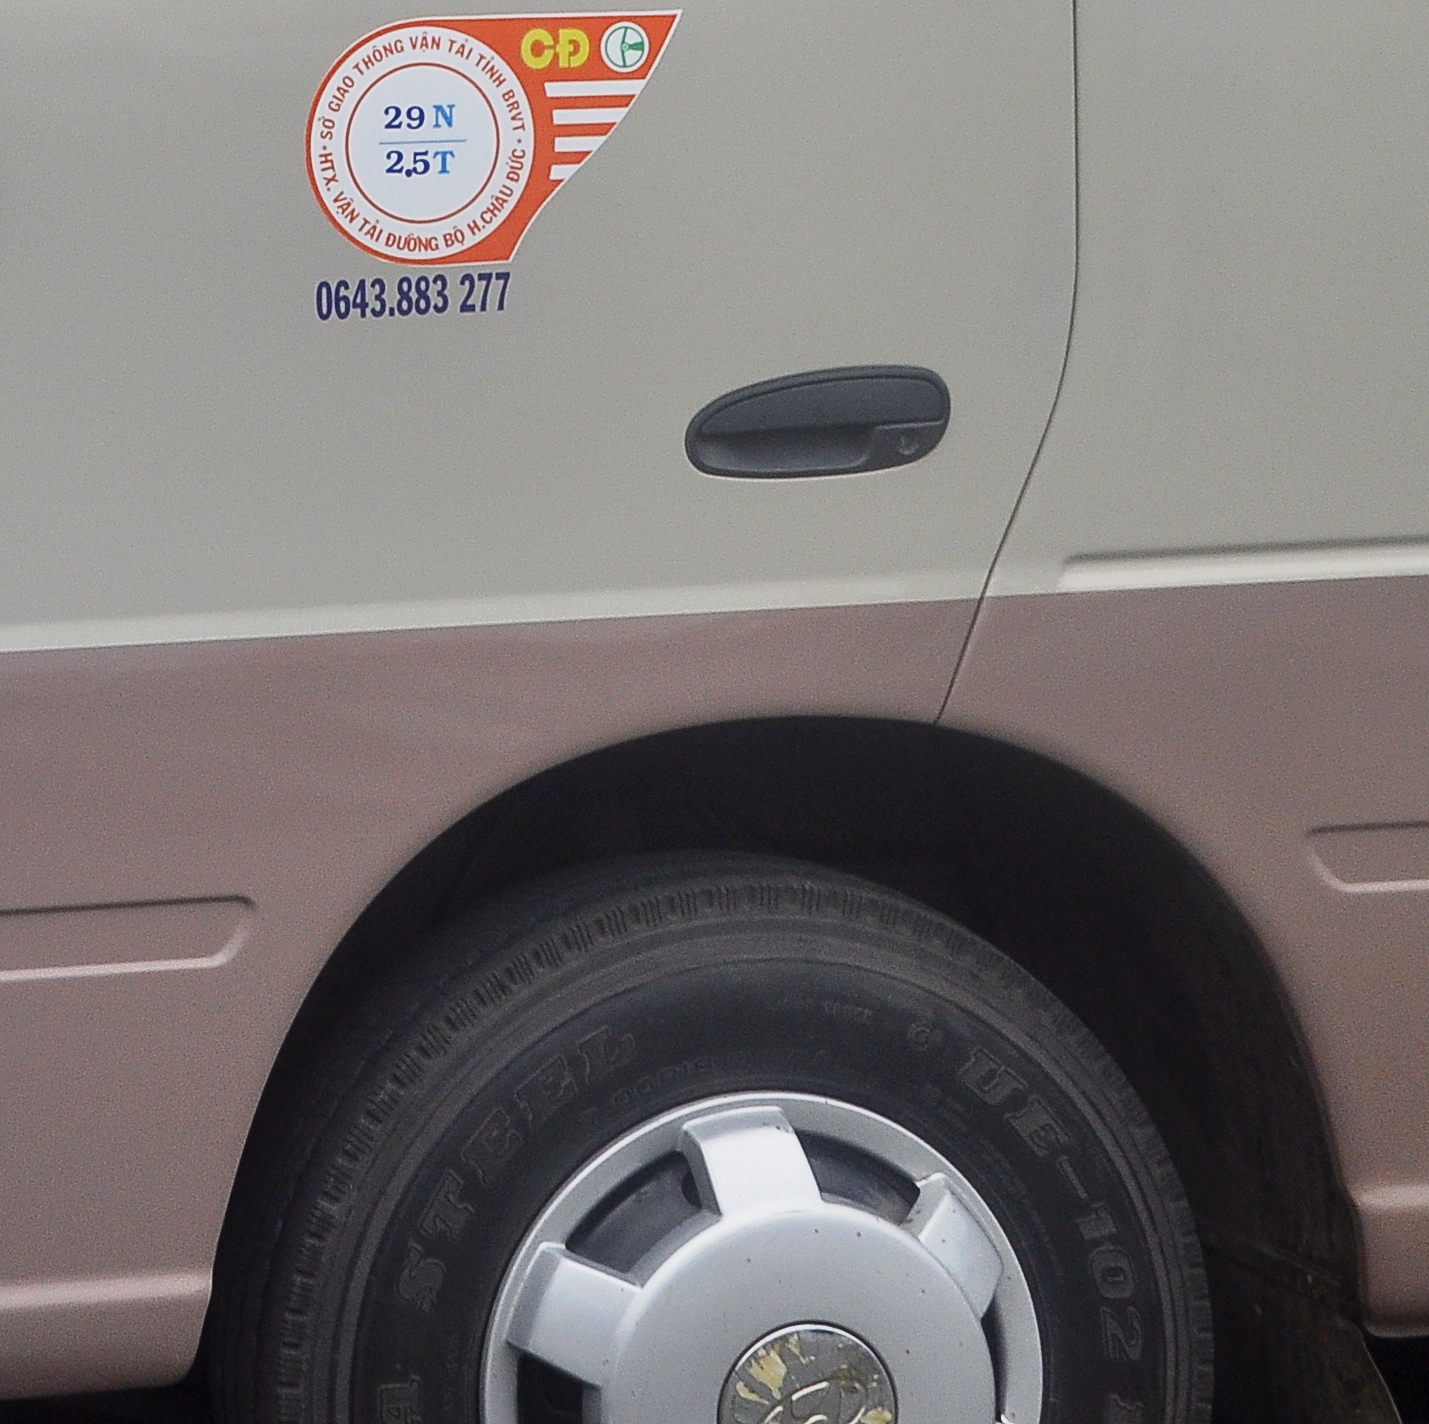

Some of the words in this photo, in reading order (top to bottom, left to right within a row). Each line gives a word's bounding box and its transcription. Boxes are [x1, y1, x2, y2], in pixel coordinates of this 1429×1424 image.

[327, 74, 356, 114] GIAO
[352, 39, 405, 77] THÔNG
[409, 31, 441, 53] VẬN
[447, 37, 474, 62] TẢI
[474, 52, 507, 89] TỈNH
[501, 88, 526, 133] BRVT
[521, 27, 591, 70] CĐ
[383, 105, 426, 131] 29
[432, 104, 456, 129] N
[432, 150, 456, 175] T
[318, 152, 340, 192] HTX.
[331, 191, 361, 225] VẬN
[357, 218, 384, 244] TẢI
[443, 225, 467, 249] BỘ
[315, 273, 450, 321] 0643.883
[459, 271, 512, 313] 277
[393, 1024, 639, 1314] STEEL
[956, 1047, 1145, 1363] UE-102
